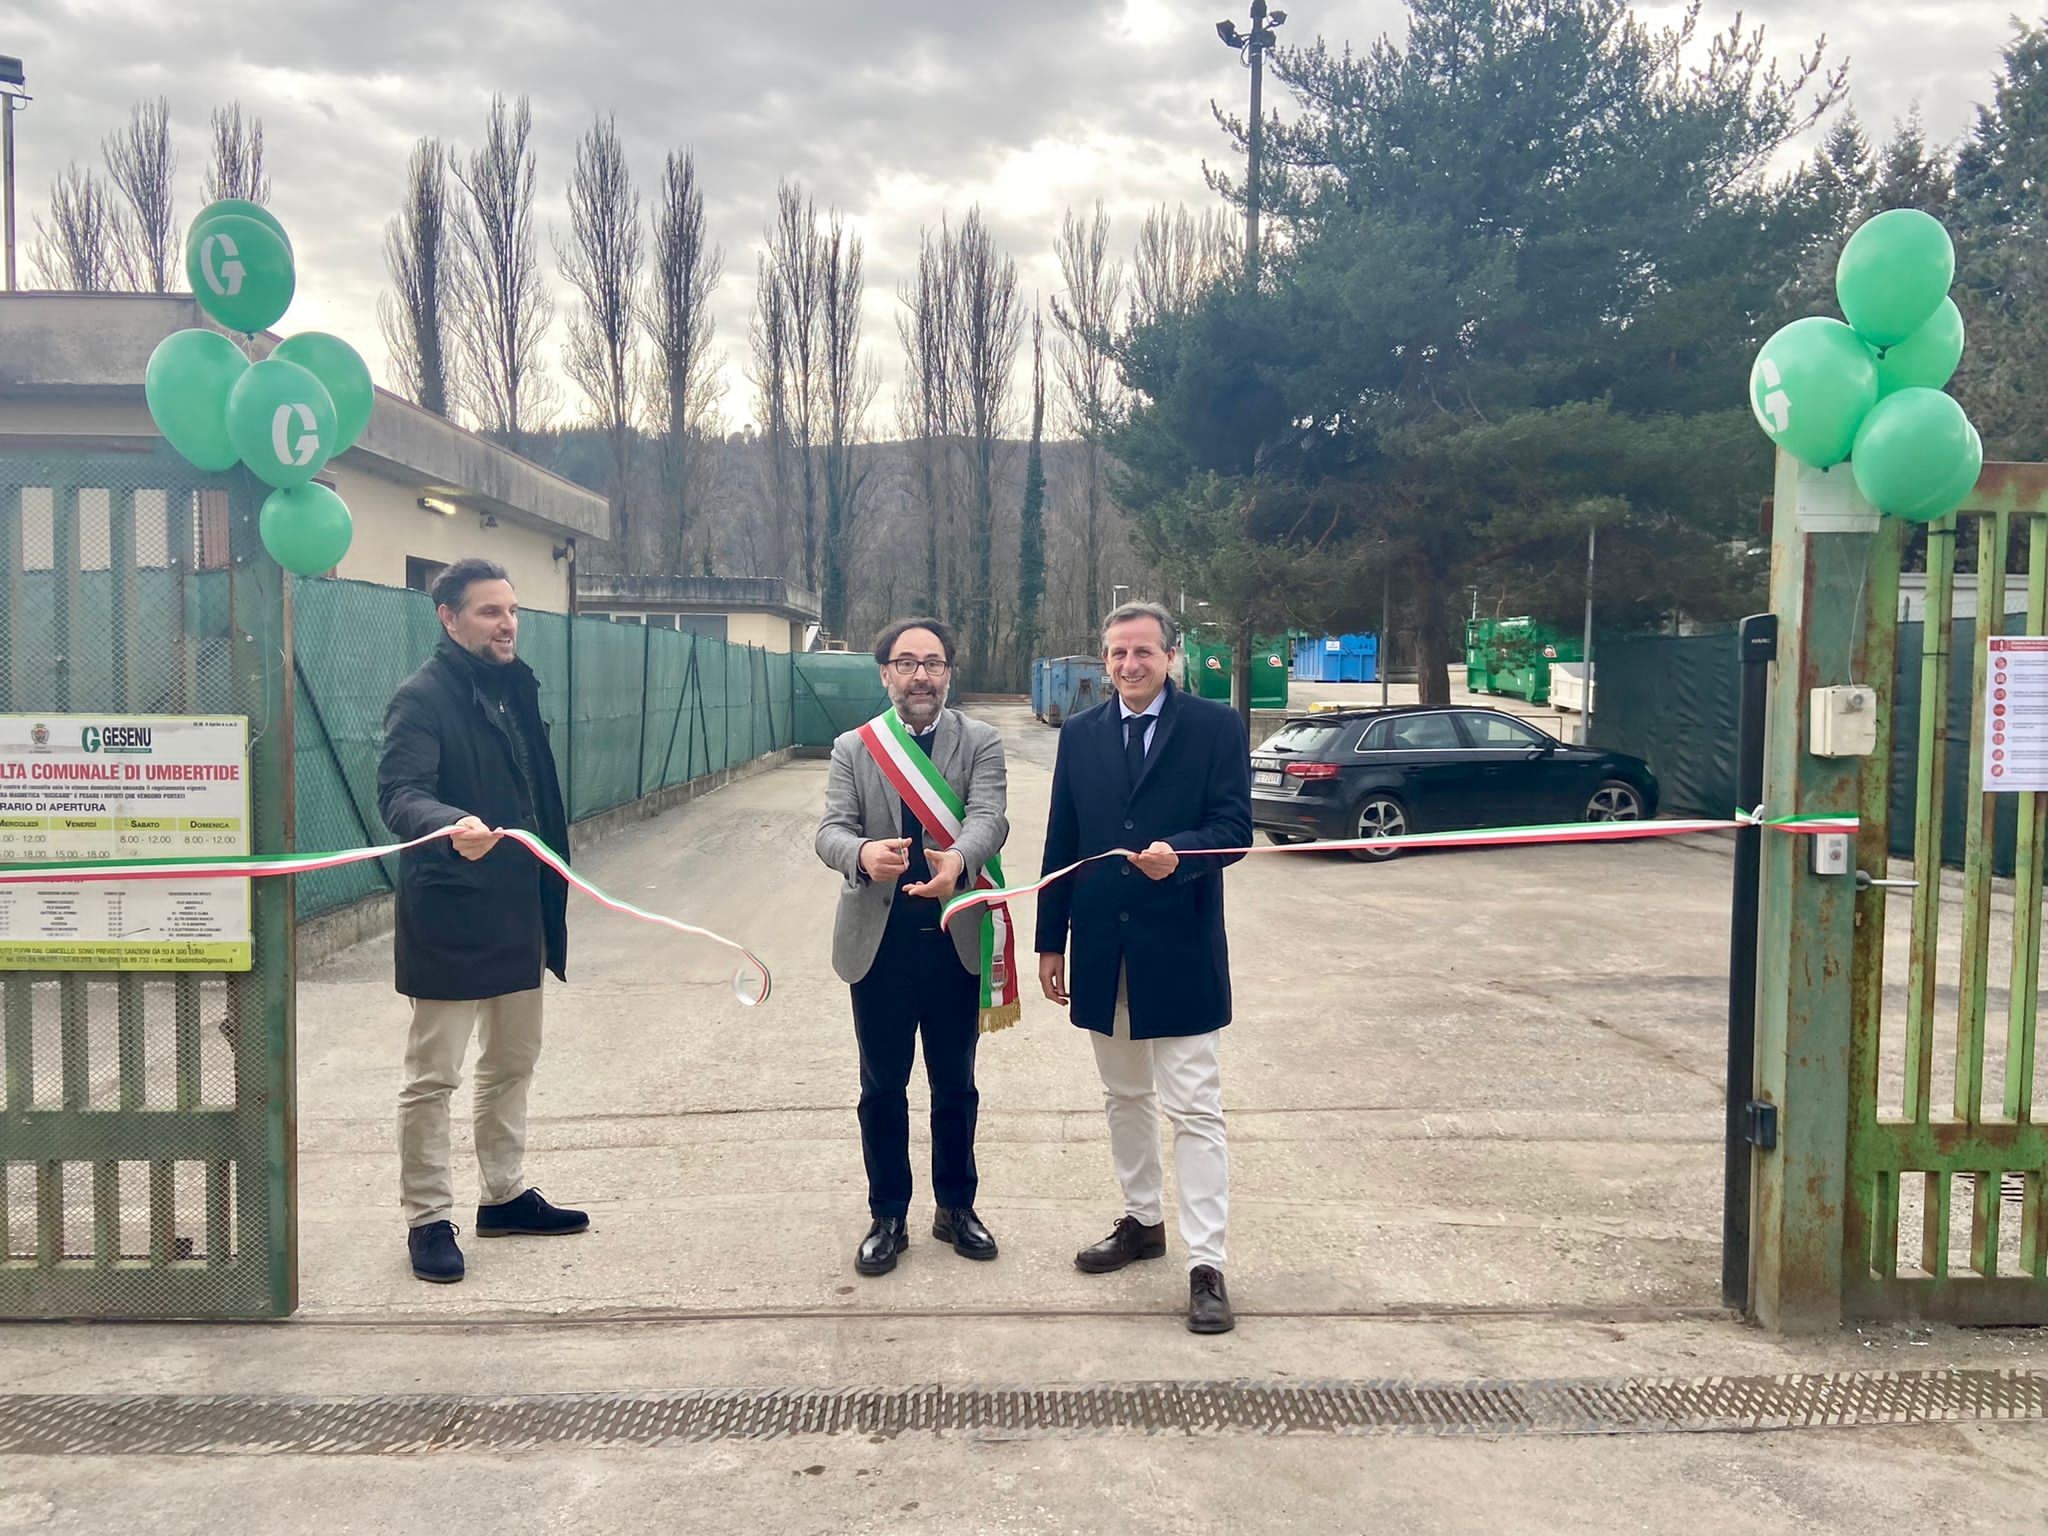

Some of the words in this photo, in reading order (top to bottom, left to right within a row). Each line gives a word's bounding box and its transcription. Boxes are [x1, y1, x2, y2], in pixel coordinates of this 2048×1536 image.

[103, 727, 151, 747] GESENU
[32, 764, 119, 780] COMUNALE
[125, 765, 140, 780] DI
[145, 765, 239, 780] UMBERTIDE
[0, 803, 33, 811] RARIO
[36, 803, 46, 811] DI
[49, 803, 106, 811] APERTURA
[23, 835, 46, 843] 12.00
[120, 835, 140, 844] 8.00
[148, 835, 171, 844] 12.00
[184, 836, 204, 844] 8.00
[213, 836, 236, 844] 12.00
[55, 850, 78, 858] 15.00
